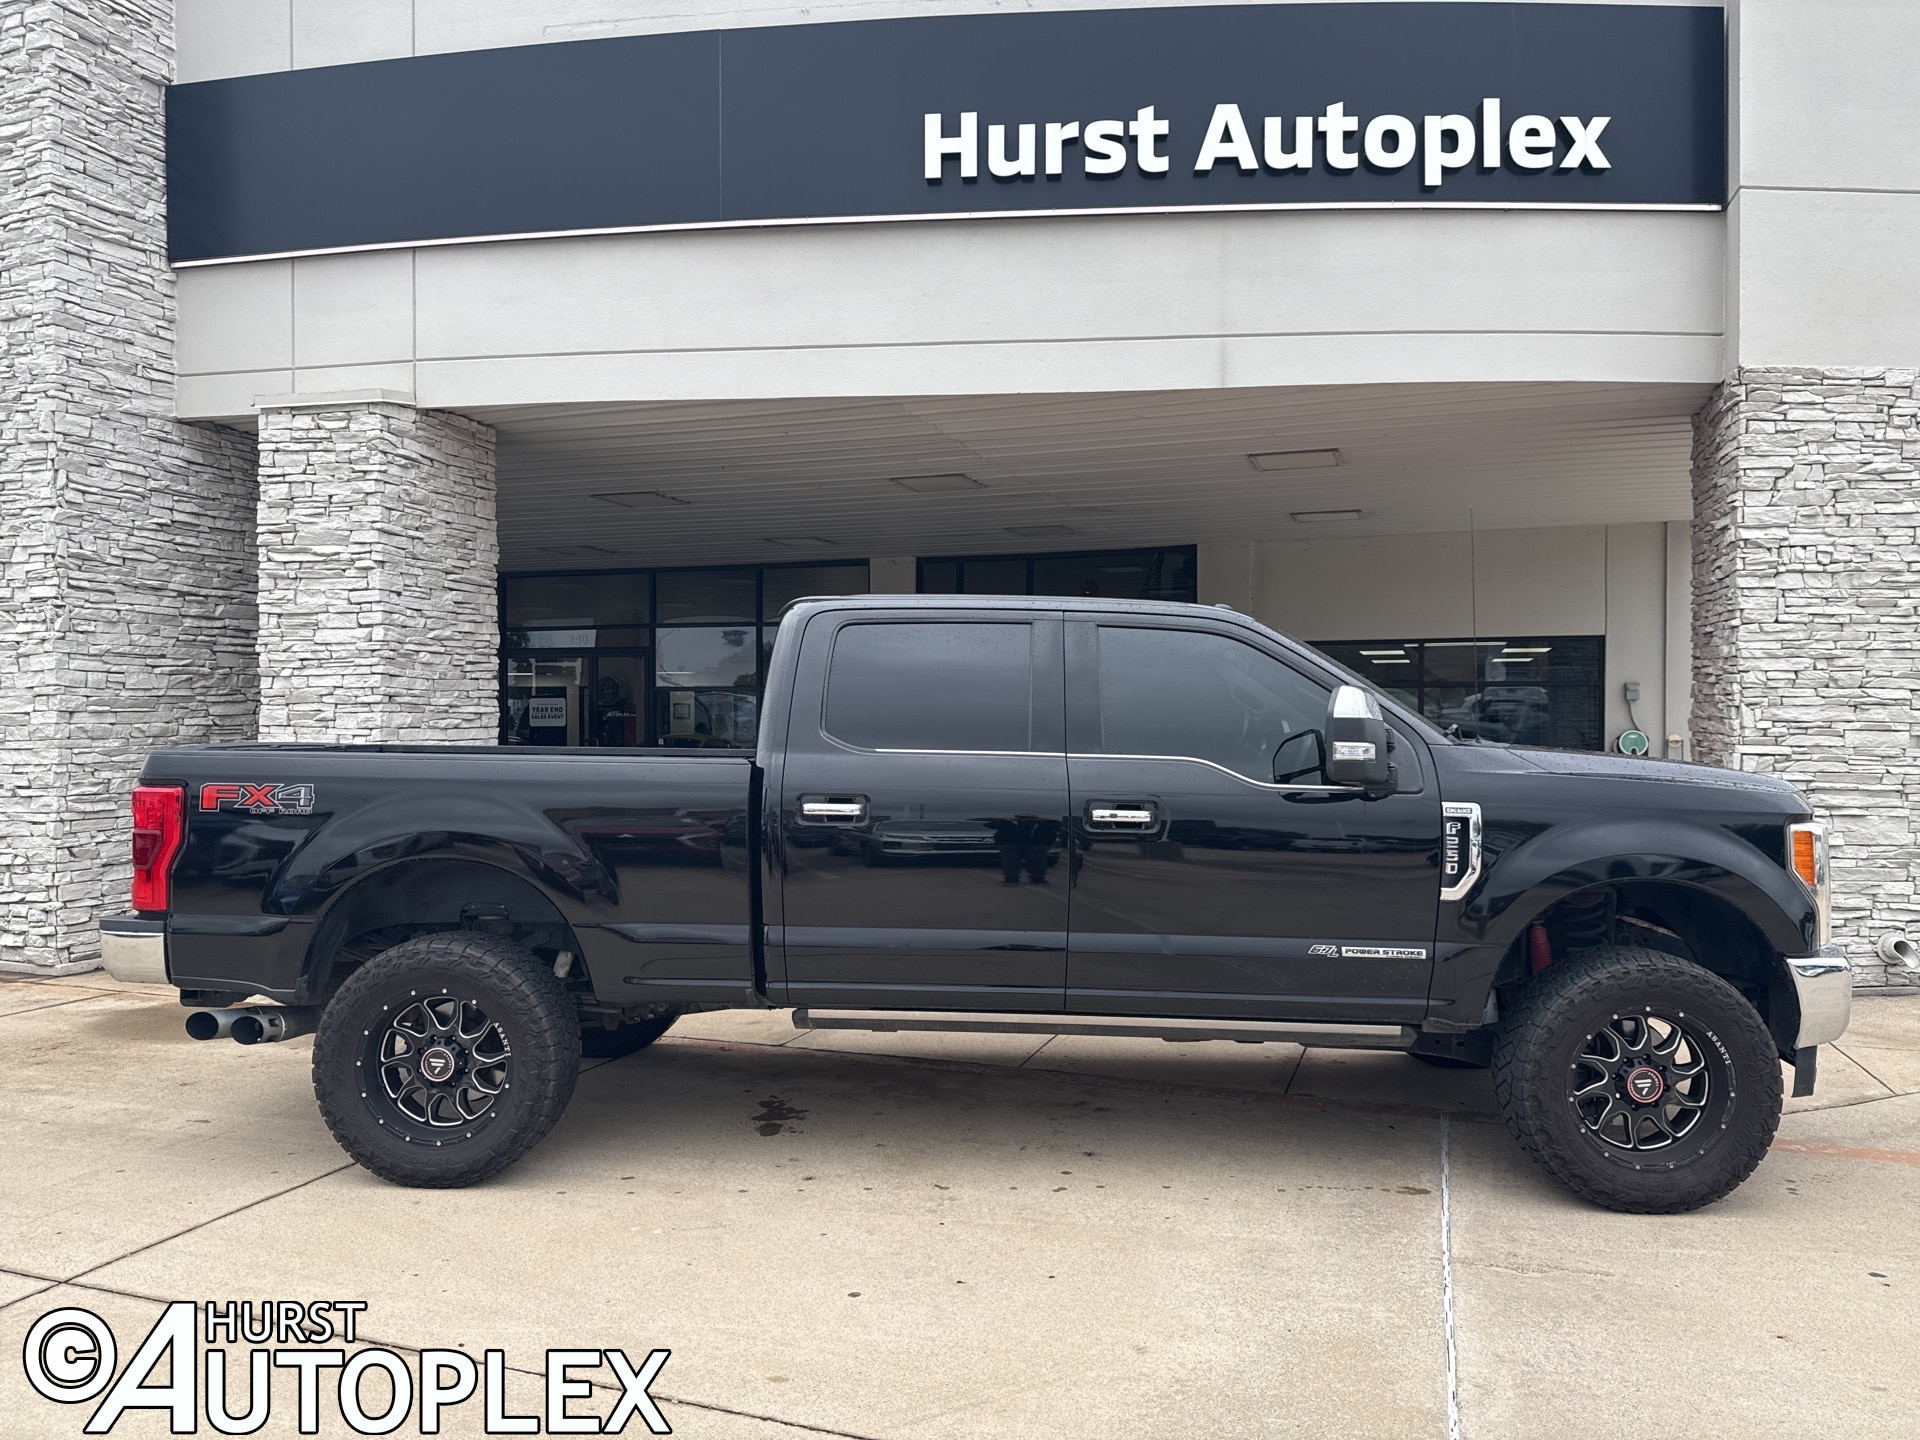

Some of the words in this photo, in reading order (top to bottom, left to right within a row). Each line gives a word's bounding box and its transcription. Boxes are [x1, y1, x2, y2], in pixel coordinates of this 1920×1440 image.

[924, 104, 1170, 180] Hurst
[1194, 98, 1612, 187] Autoplex
[199, 782, 315, 812] FX4
[1382, 949, 1424, 957] STROKE
[493, 1022, 511, 1057] ASANTI
[1706, 1031, 1731, 1065] ASANTI
